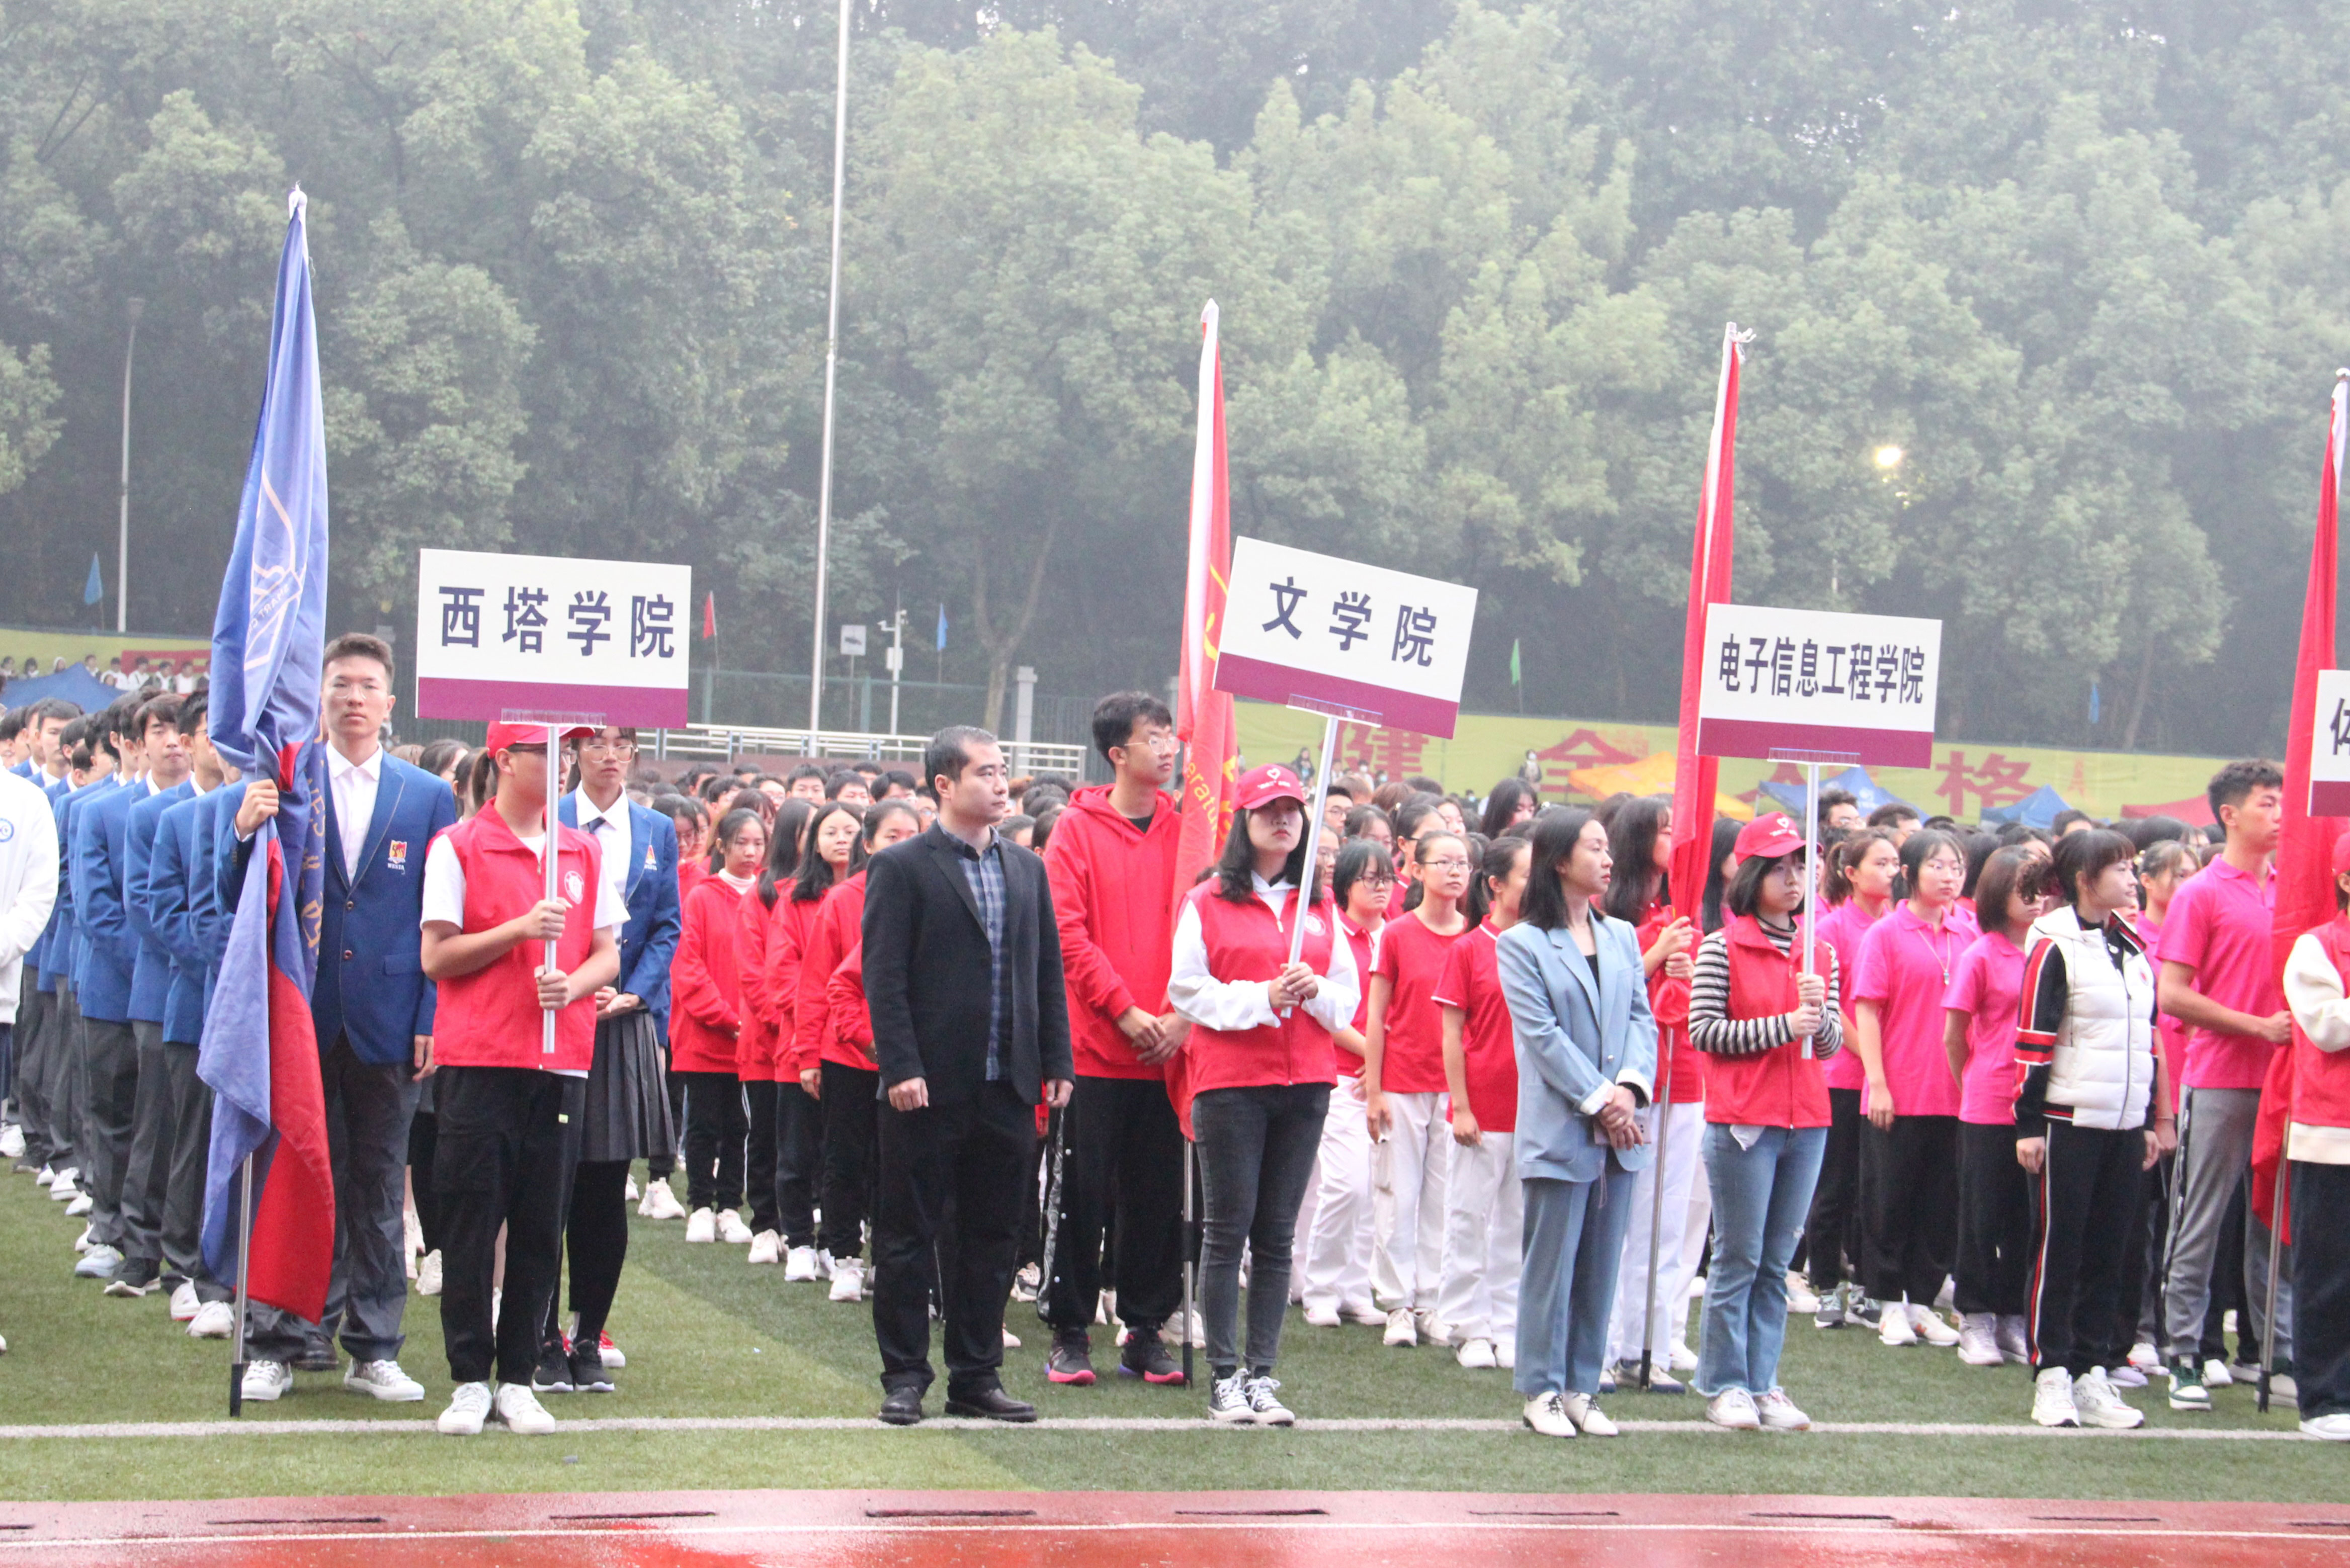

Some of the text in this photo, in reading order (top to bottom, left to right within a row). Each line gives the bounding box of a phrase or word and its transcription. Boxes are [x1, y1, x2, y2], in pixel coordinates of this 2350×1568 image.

[439, 586, 675, 658] 西塔学院
[1262, 576, 1437, 667] 文学院
[1719, 633, 1925, 705] 电子信息工程学院
